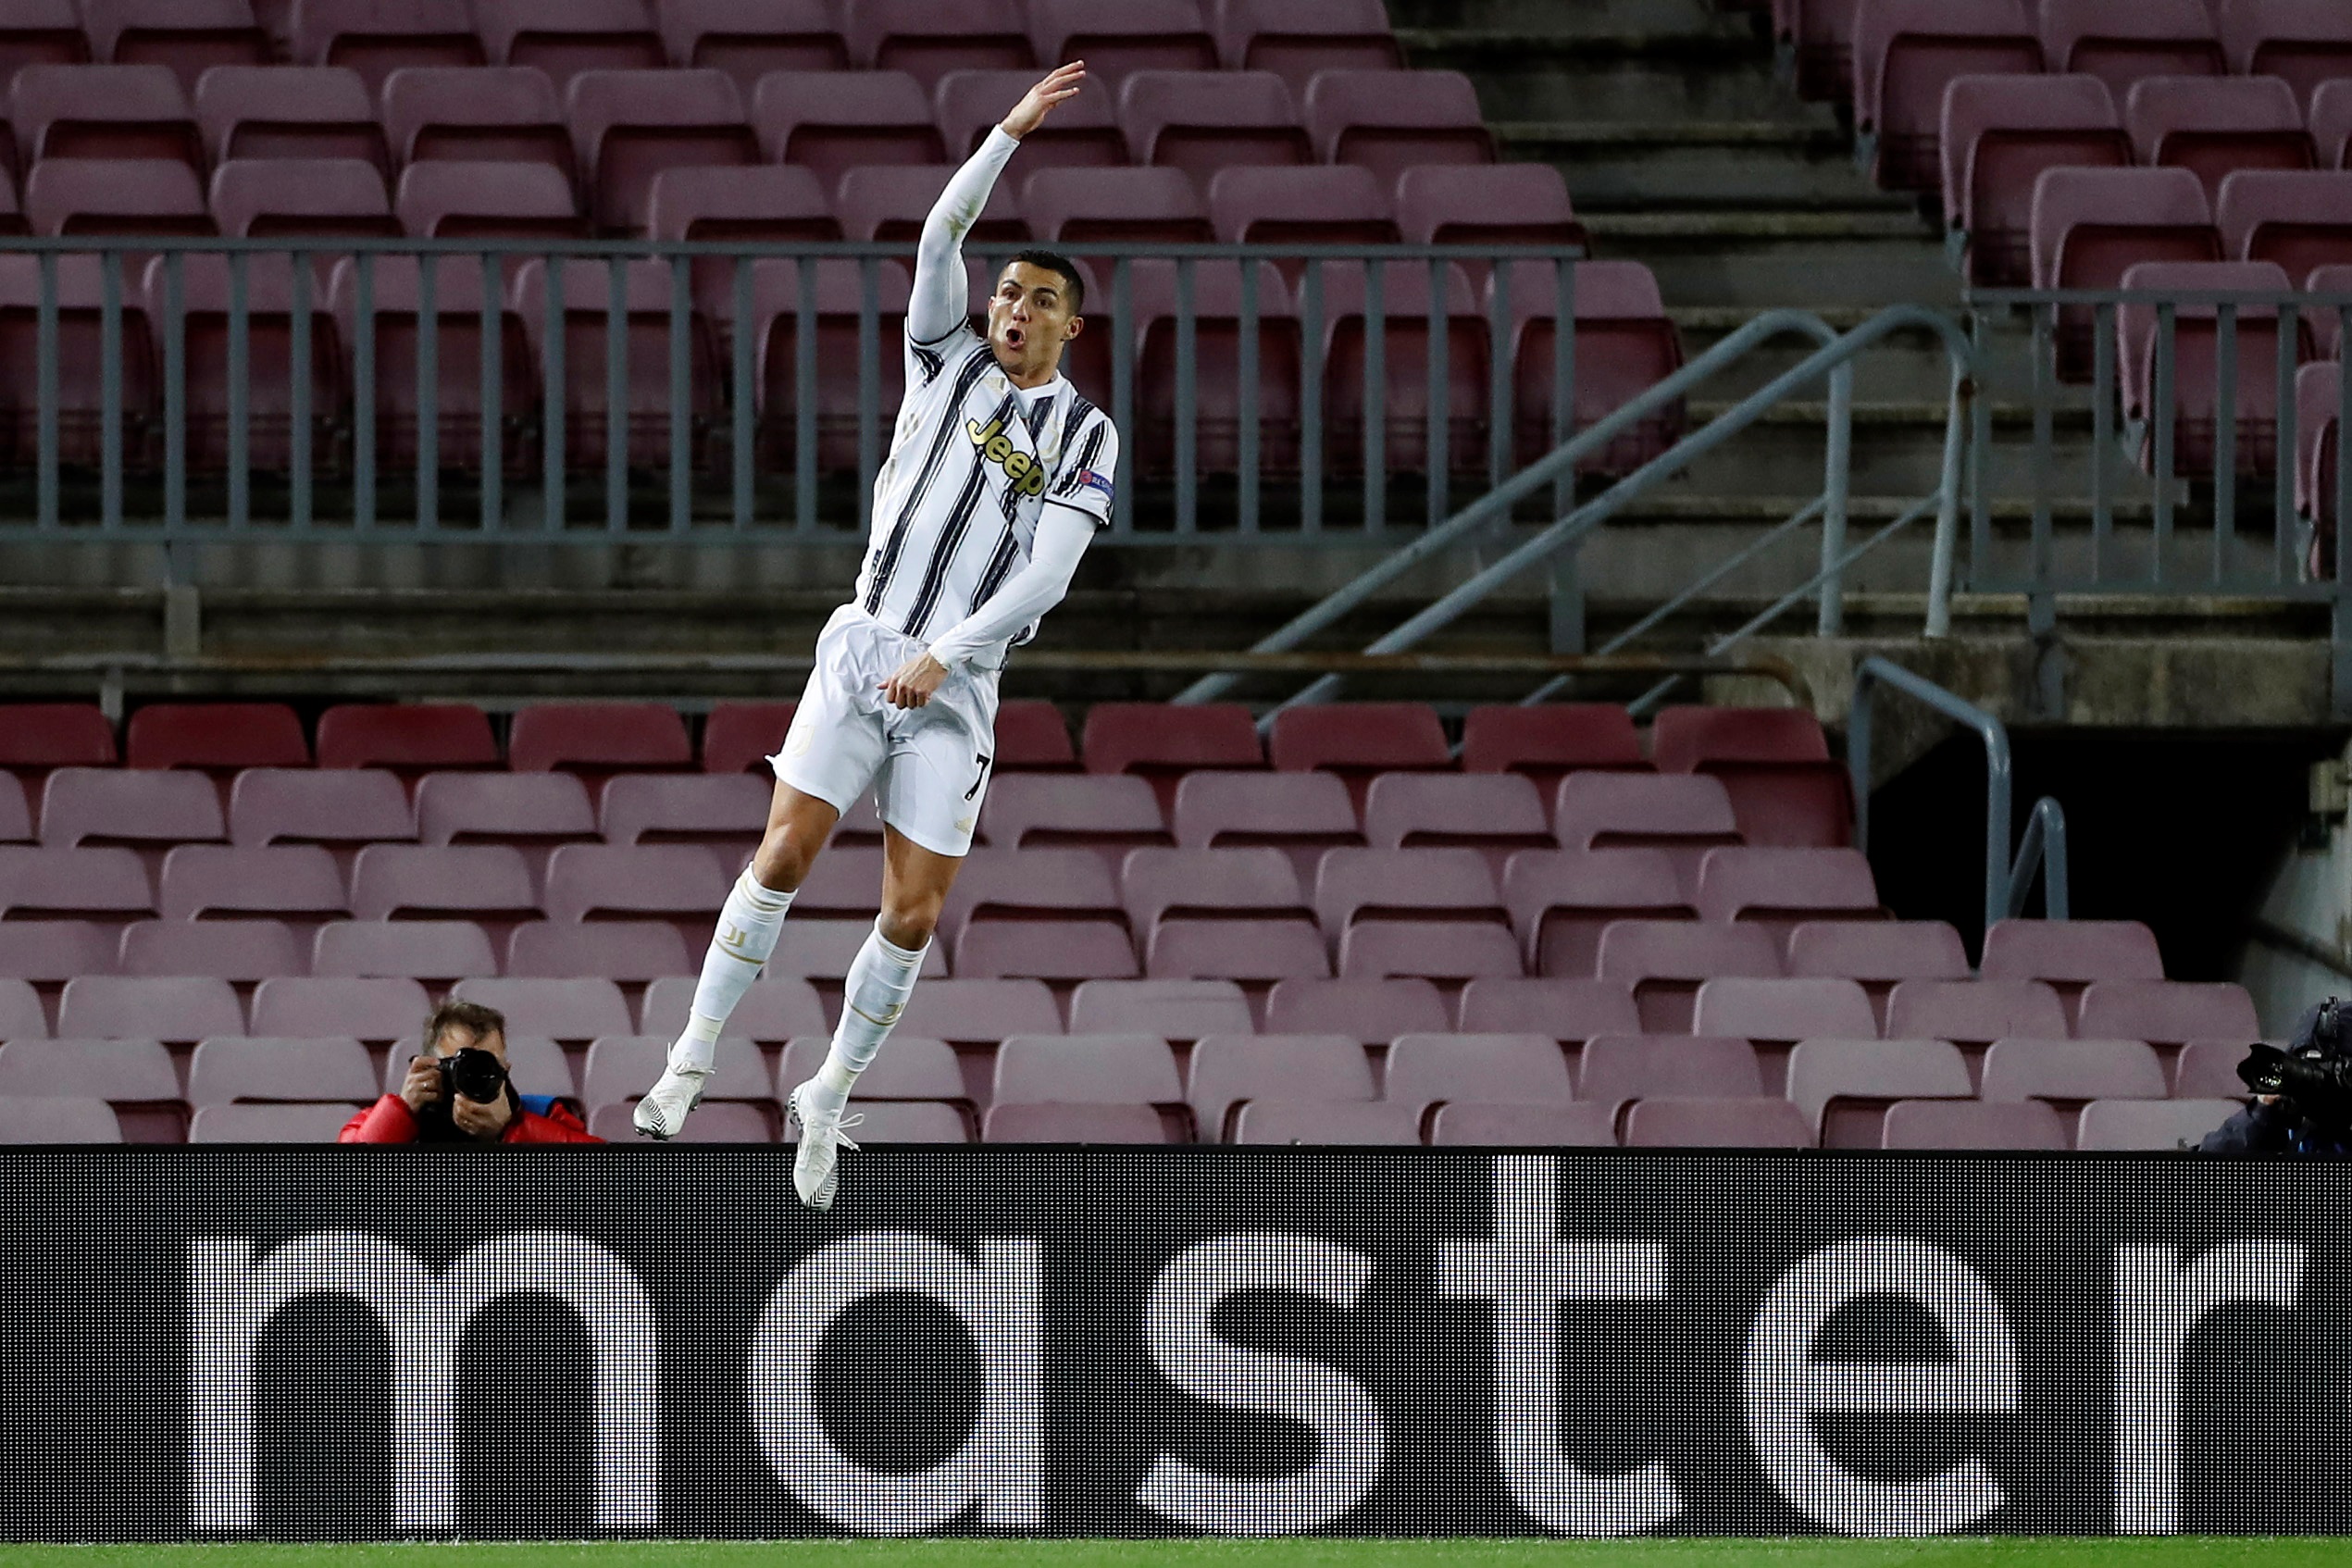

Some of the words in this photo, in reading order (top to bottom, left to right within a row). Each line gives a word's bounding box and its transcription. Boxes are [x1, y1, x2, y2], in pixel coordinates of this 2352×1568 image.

[966, 418, 1045, 496] Jeep
[964, 753, 990, 801] 7
[189, 1154, 2306, 1538] master
